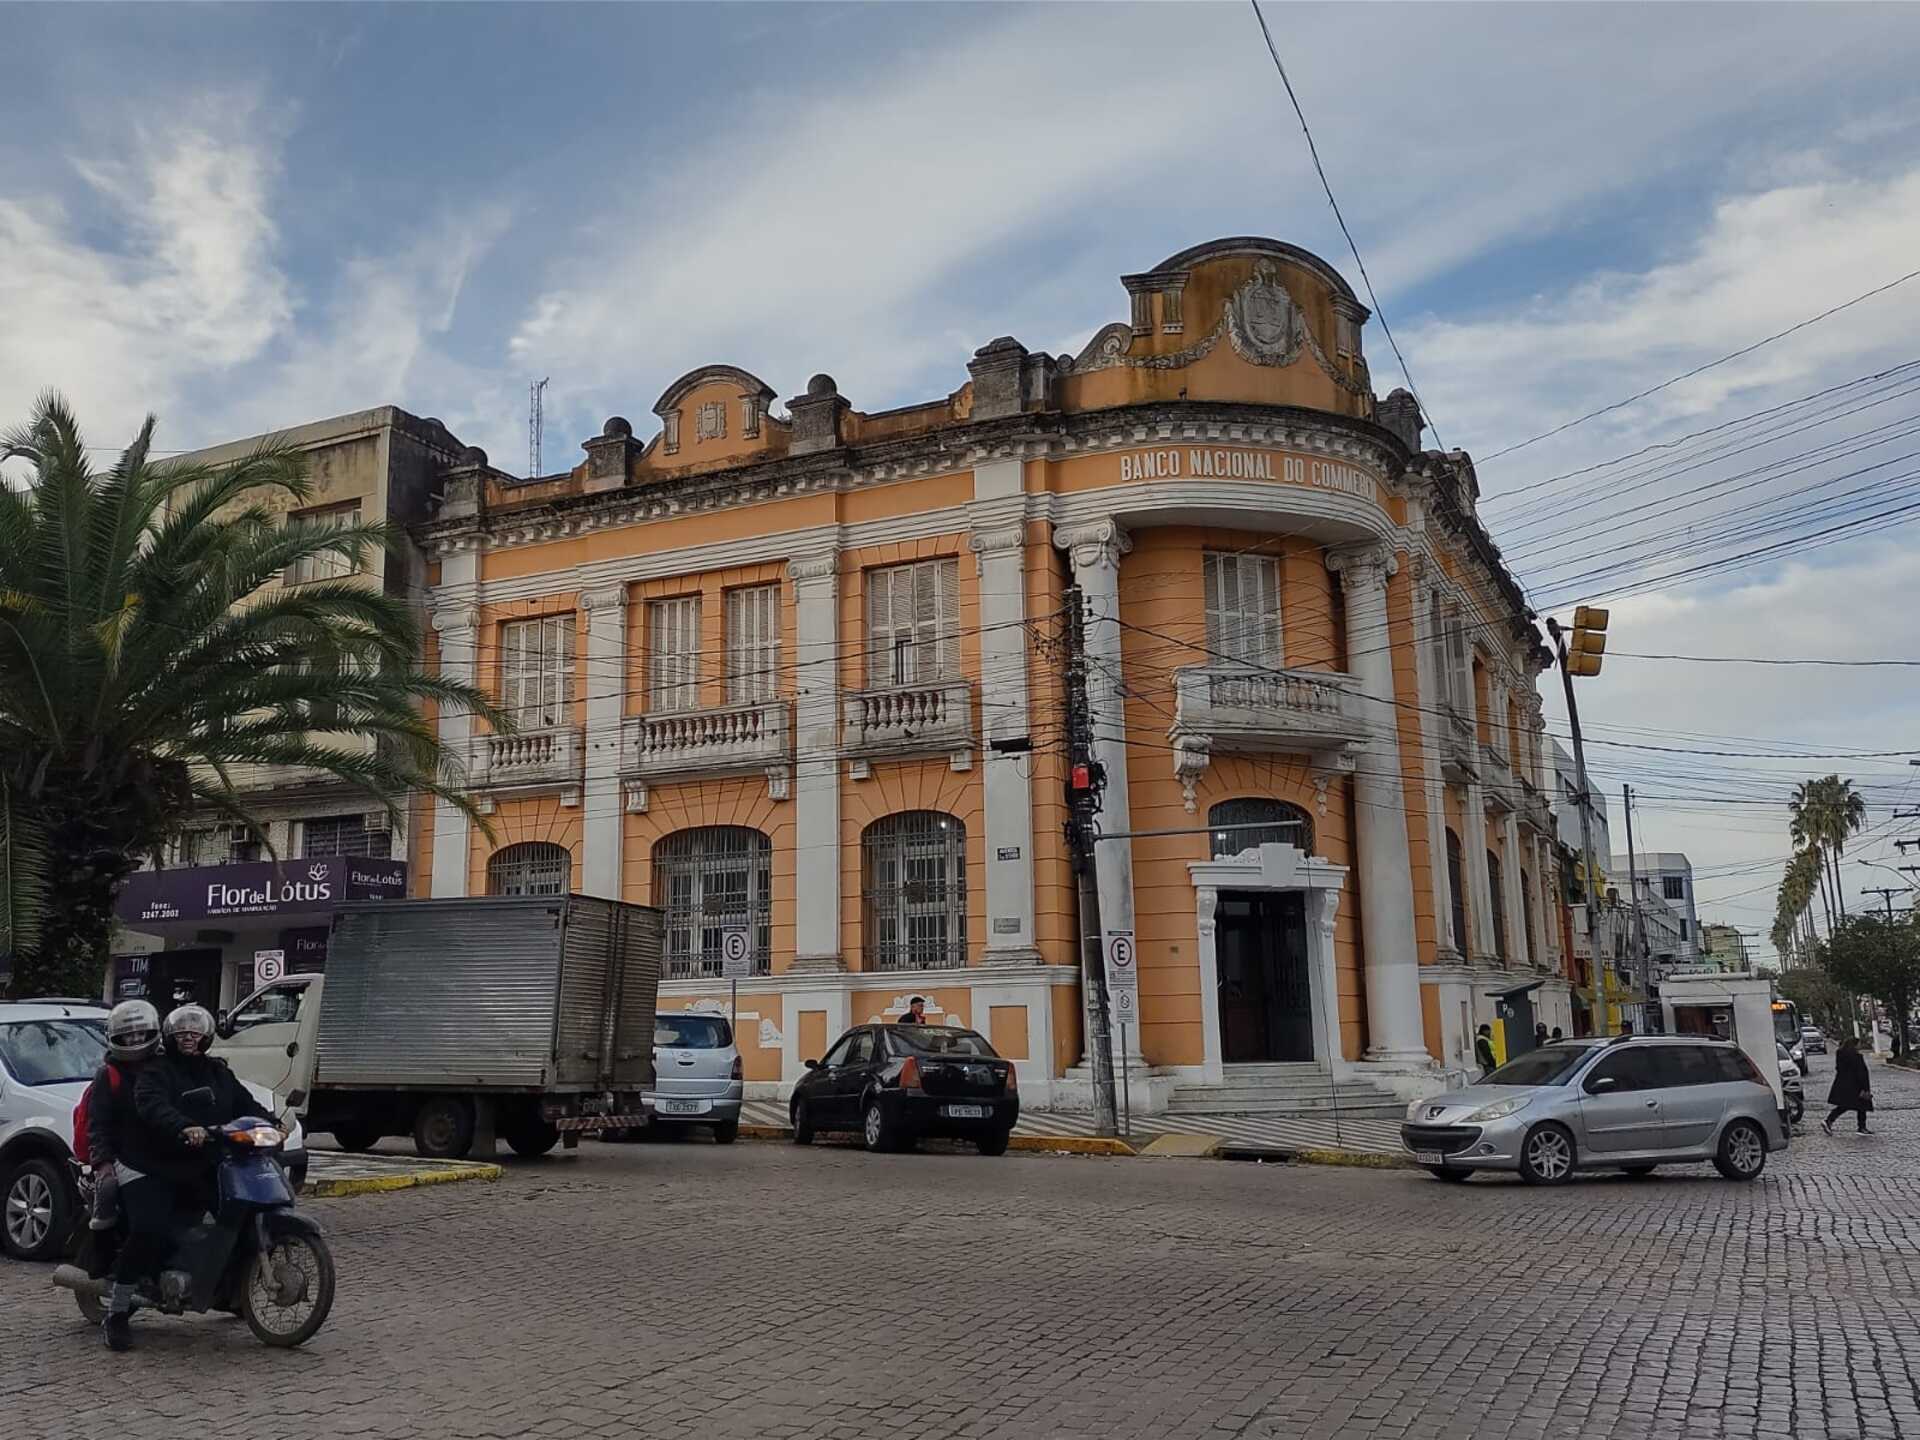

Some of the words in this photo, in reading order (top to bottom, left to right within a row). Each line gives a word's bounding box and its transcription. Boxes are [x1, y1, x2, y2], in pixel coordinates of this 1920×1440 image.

[1120, 450, 1180, 481] BANCO
[1189, 450, 1277, 480] NACIONAL
[1283, 456, 1305, 483] DO
[207, 884, 251, 907] Flor
[249, 890, 265, 904] de
[265, 880, 331, 903] Lótus
[732, 939, 739, 955] E
[1117, 943, 1125, 961] E
[265, 962, 273, 976] E
